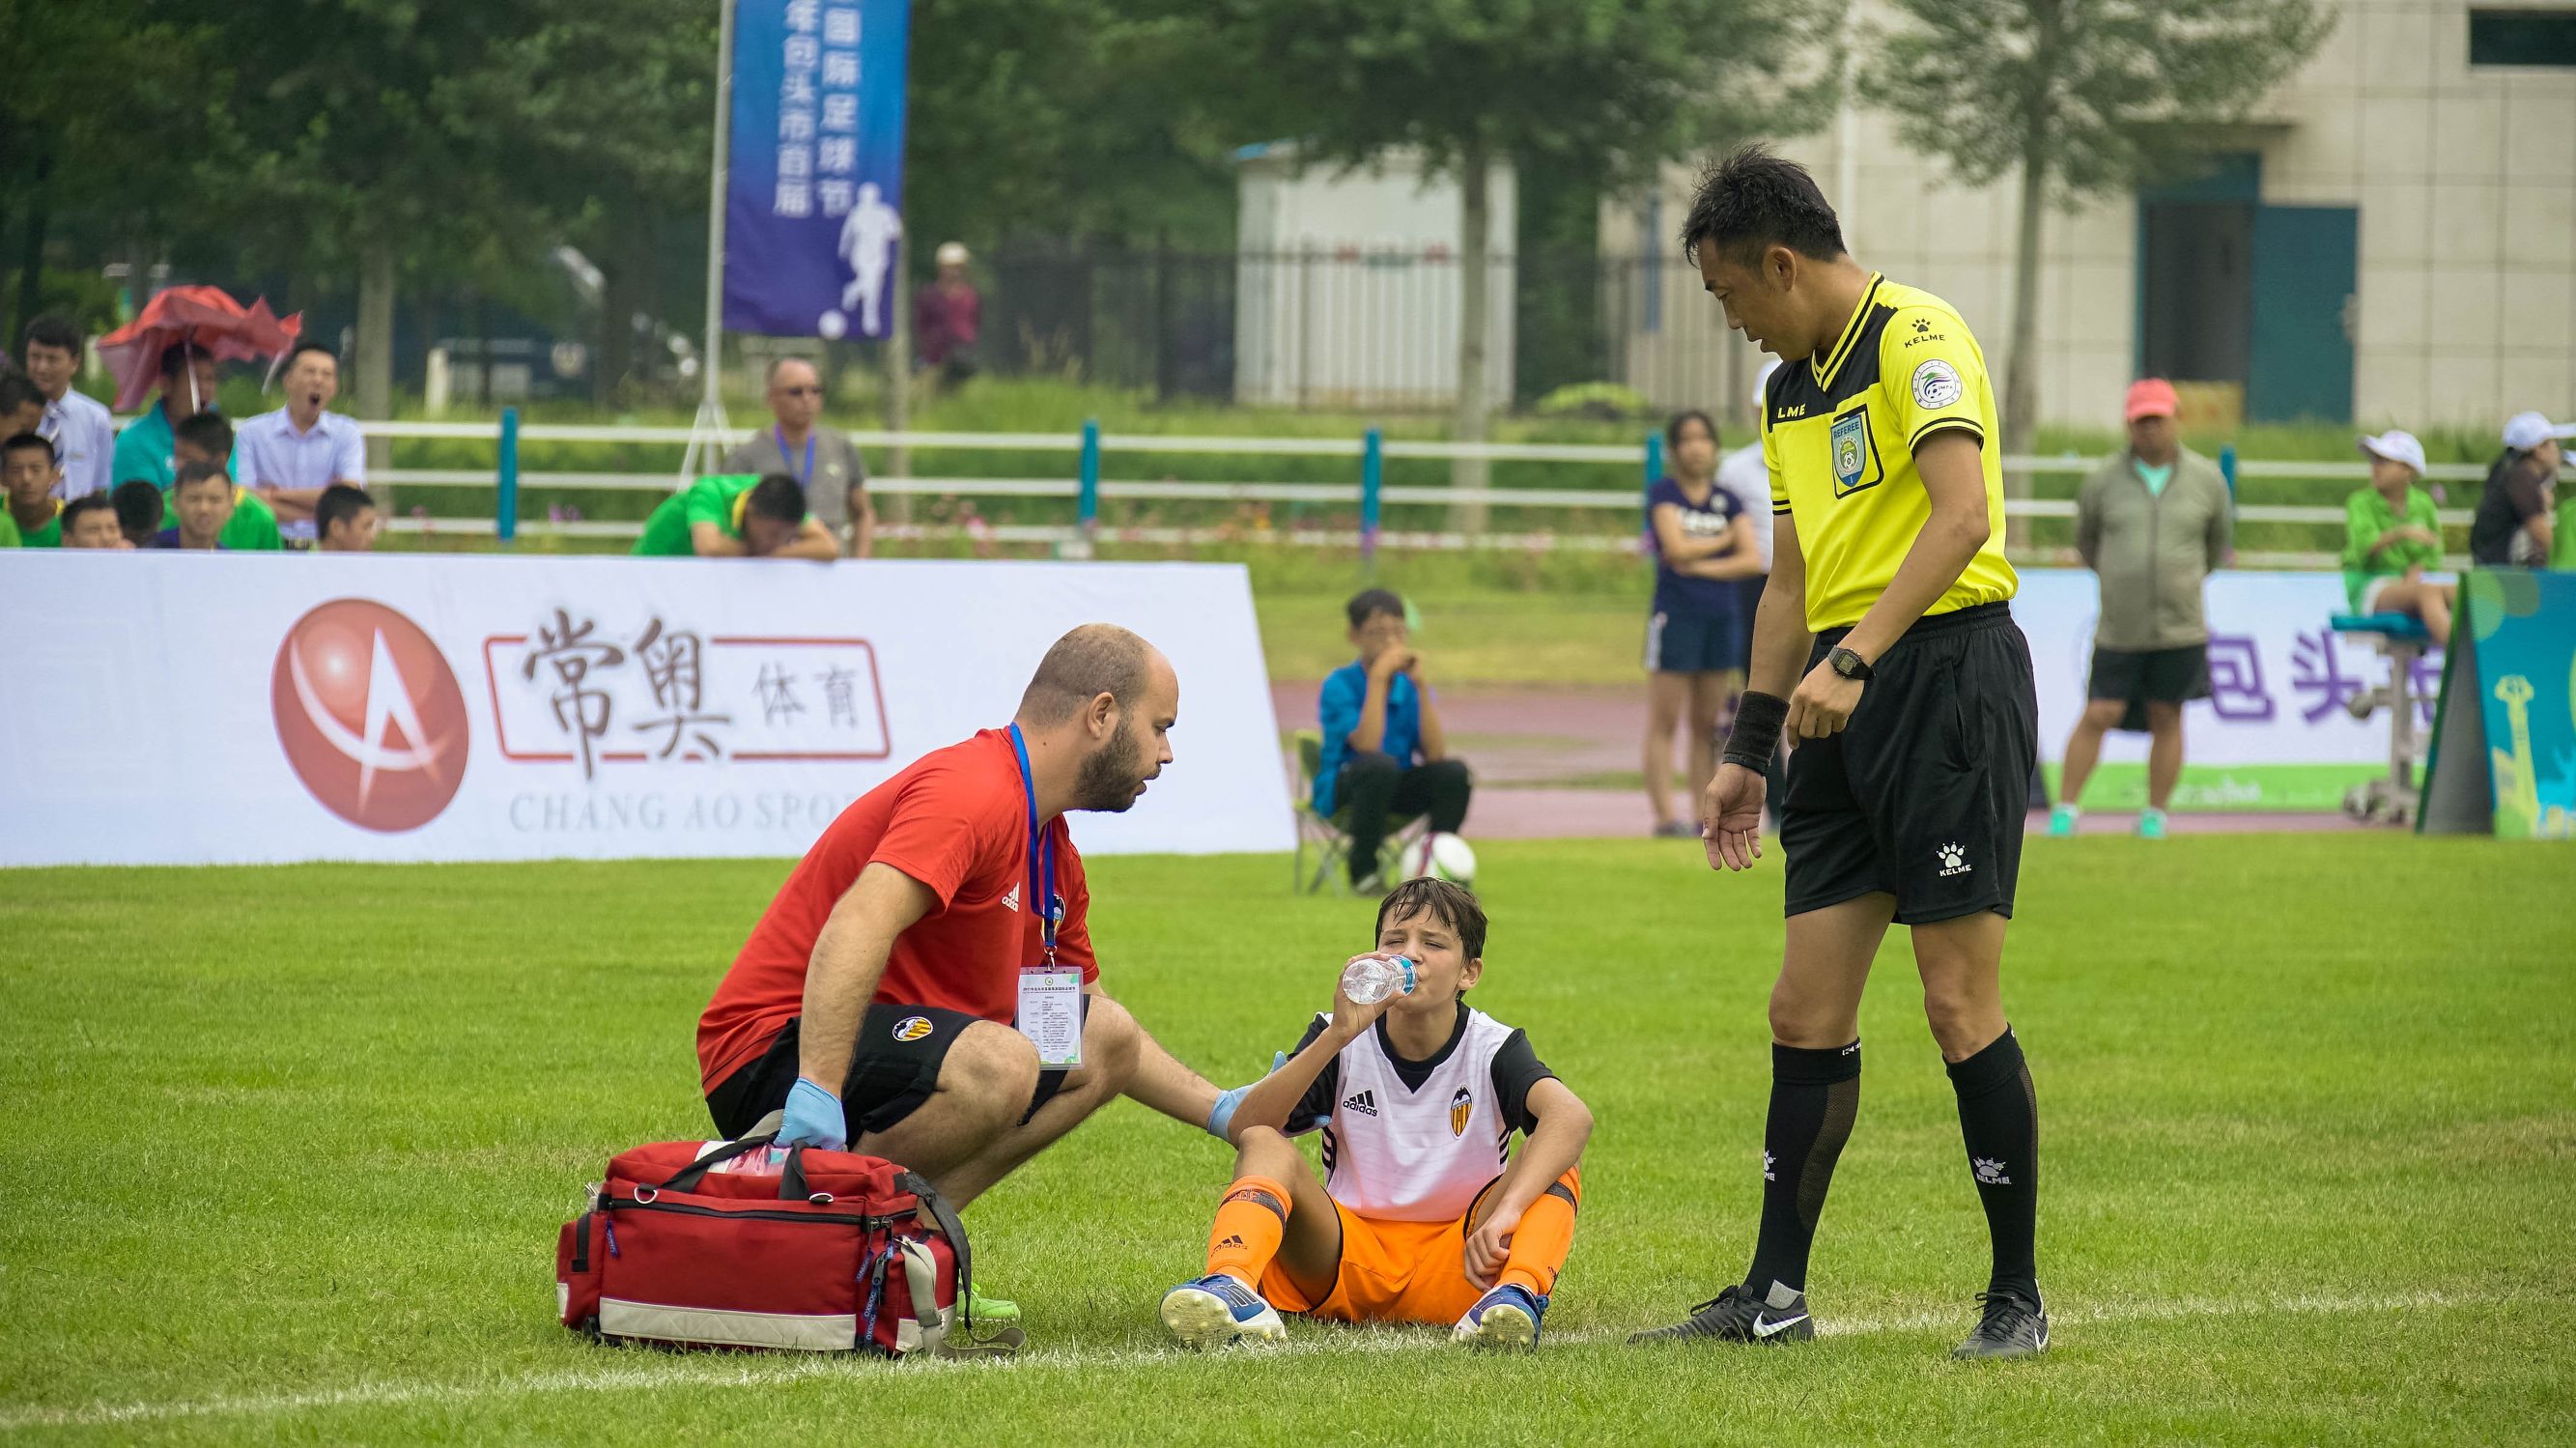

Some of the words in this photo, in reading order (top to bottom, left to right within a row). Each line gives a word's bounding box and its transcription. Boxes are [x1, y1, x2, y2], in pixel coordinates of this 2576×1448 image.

[817, 0, 862, 217] 国际足球节
[1905, 333, 1946, 349] KELME
[1832, 421, 1860, 440] REFEREE
[523, 608, 730, 780] 常奥
[752, 662, 859, 729] 体育
[509, 791, 666, 833] CHANG
[683, 791, 742, 833] AO
[1939, 864, 1972, 877] KELME
[1343, 1099, 1378, 1118] adidas
